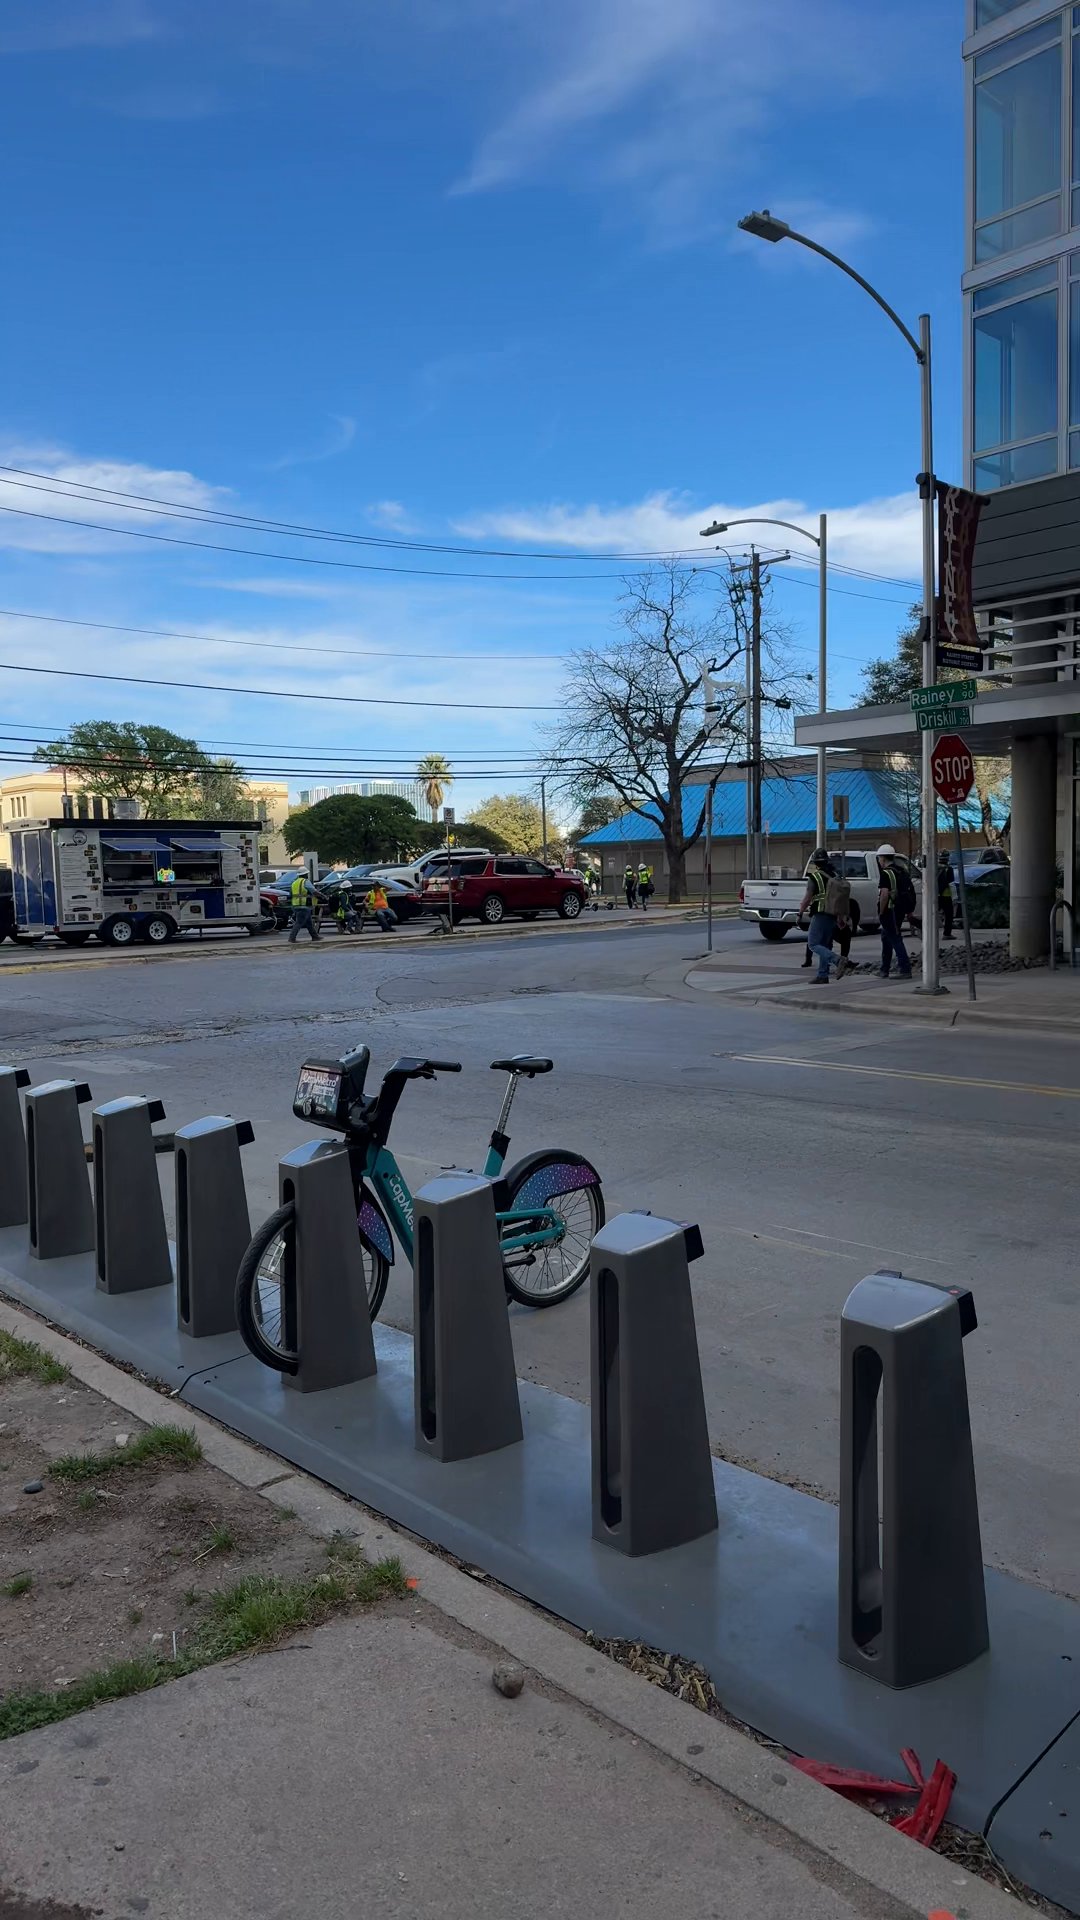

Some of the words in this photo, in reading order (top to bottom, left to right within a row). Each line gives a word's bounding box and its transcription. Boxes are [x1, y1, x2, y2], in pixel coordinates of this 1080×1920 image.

[962, 680, 973, 690] ST
[911, 689, 955, 707] Rainey
[961, 690, 974, 699] 90
[962, 707, 969, 716] ST
[919, 710, 957, 728] Driskill
[959, 717, 969, 725] 700
[934, 755, 970, 784] STOP
